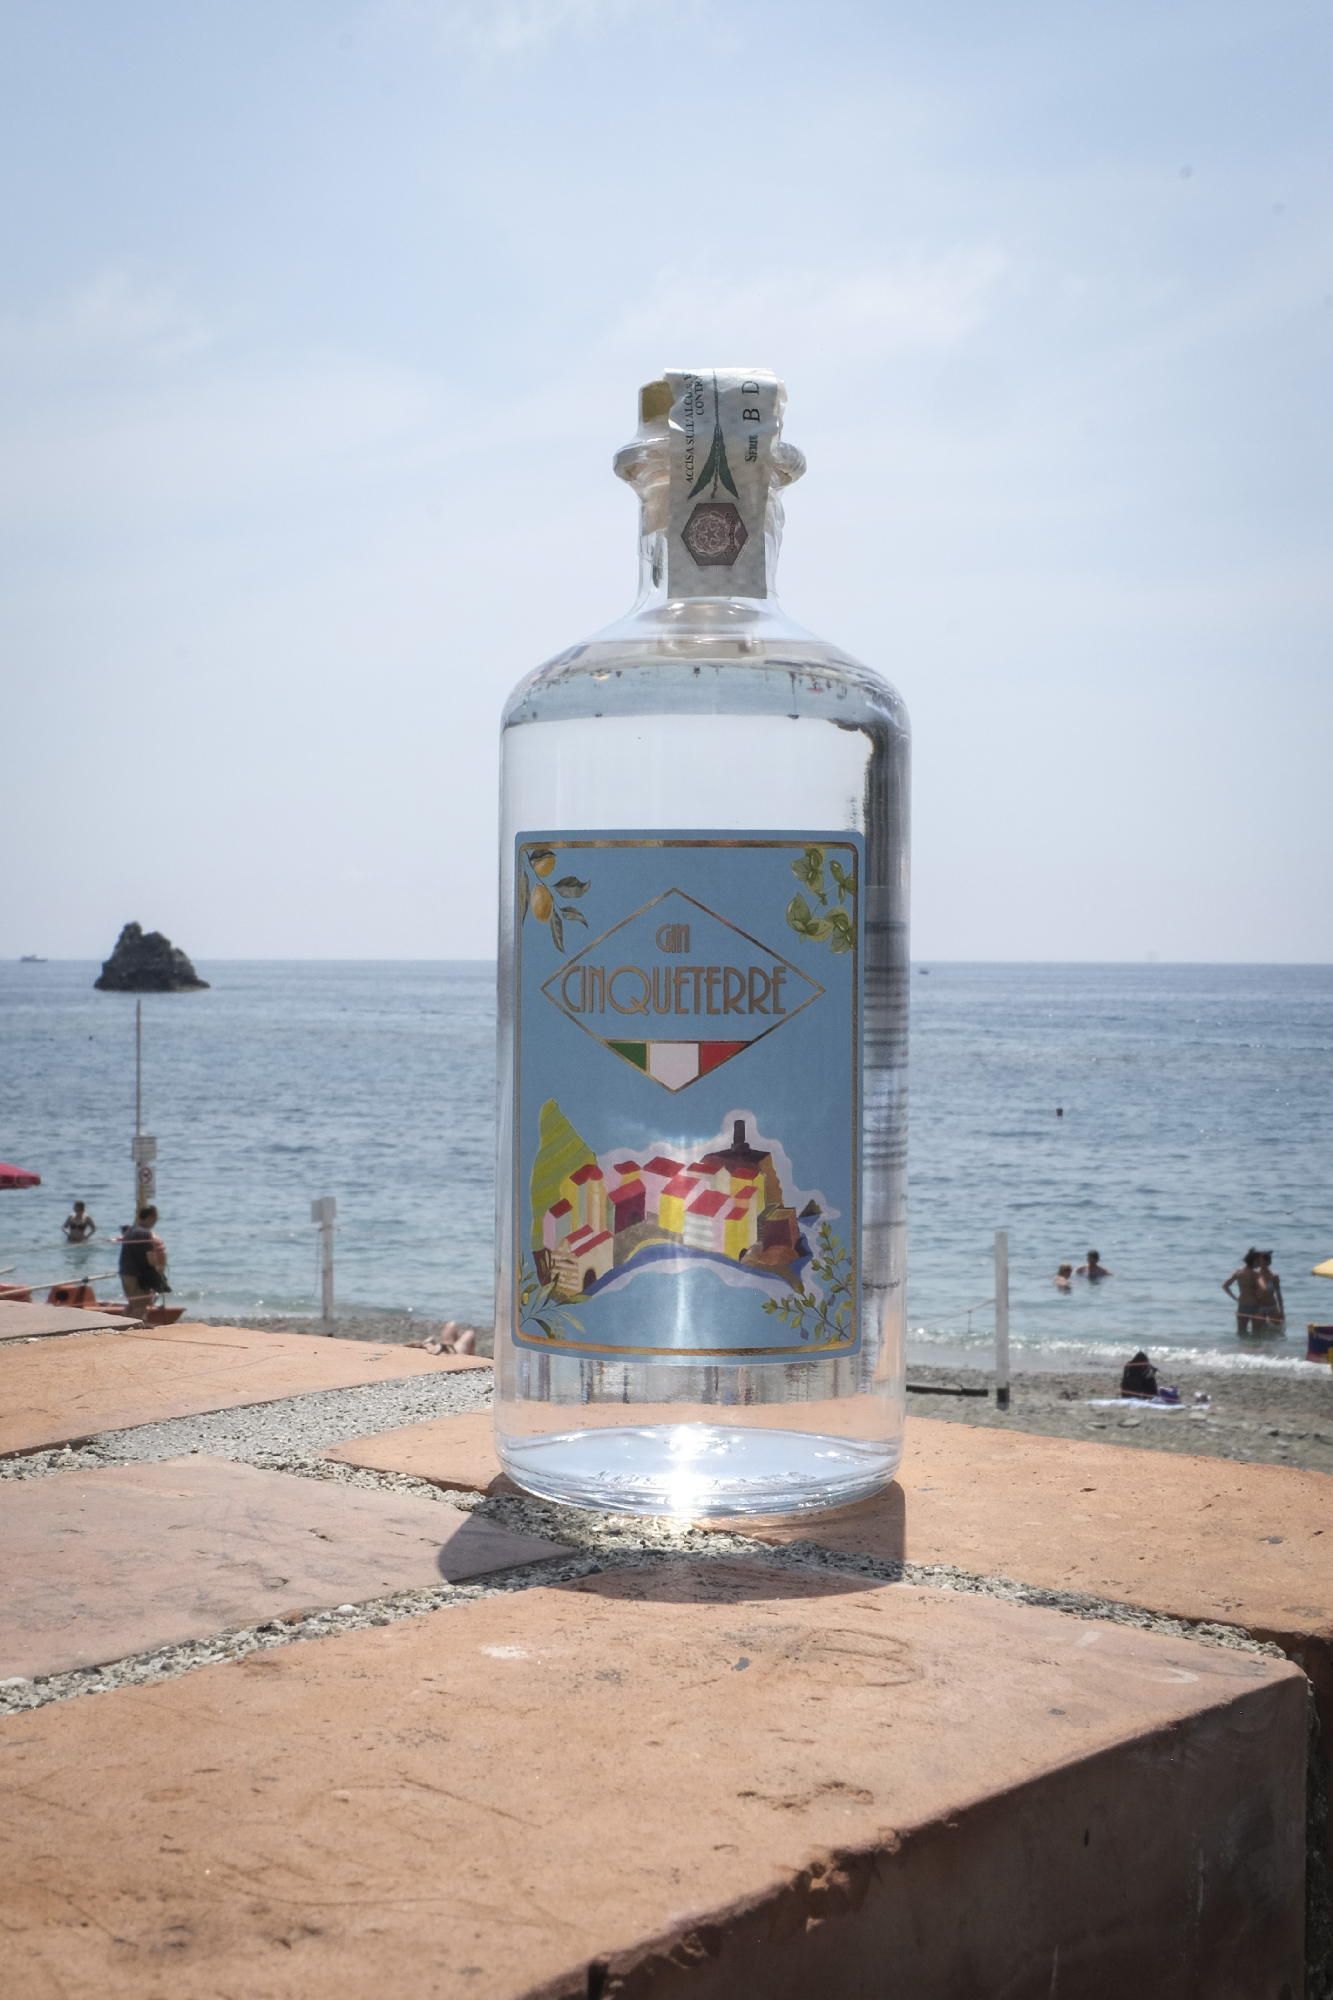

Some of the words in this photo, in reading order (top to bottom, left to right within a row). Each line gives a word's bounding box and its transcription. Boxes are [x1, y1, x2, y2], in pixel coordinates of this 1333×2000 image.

[741, 380, 760, 395] D
[743, 408, 760, 423] B
[655, 923, 690, 954] GIN
[561, 965, 788, 1016] CINQUETERRE
